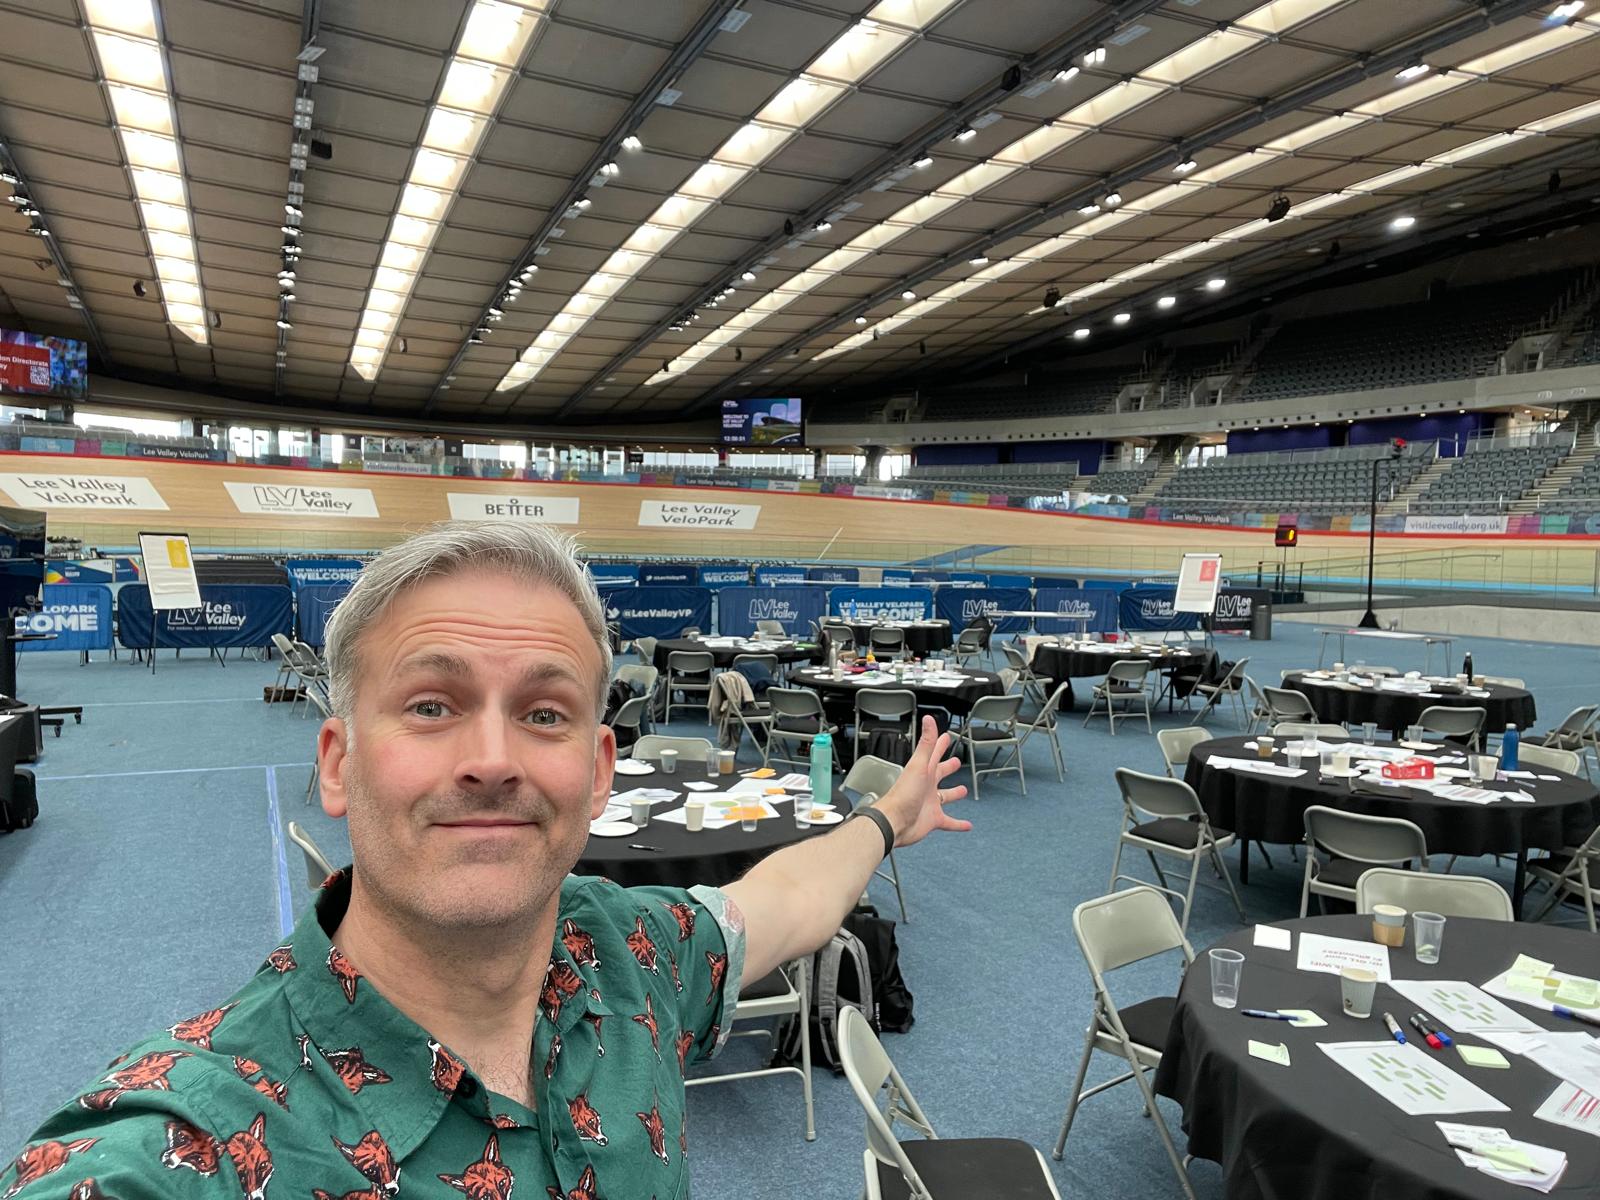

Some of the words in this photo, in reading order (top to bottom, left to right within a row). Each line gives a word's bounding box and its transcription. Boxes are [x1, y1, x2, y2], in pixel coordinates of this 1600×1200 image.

[143, 447, 155, 455] Lee
[156, 448, 178, 458] Valley
[179, 449, 209, 459] VeloPark
[18, 477, 57, 489] Lee
[60, 477, 127, 493] Valley
[34, 491, 137, 505] VeloPark
[253, 486, 298, 507] LV
[300, 488, 332, 498] Lee
[302, 498, 353, 510] Valley
[485, 501, 544, 516] BETTER
[661, 504, 688, 513] Lee
[694, 505, 740, 518] Valley
[661, 515, 735, 525] VeloPark
[1172, 512, 1184, 520] Lee
[1185, 513, 1202, 523] Valley
[1410, 520, 1501, 532] visitleevalley.org.uk
[773, 599, 790, 609] Lee
[982, 600, 999, 609] Lee
[1076, 600, 1090, 609] Lee
[1159, 600, 1171, 608] Lee
[1216, 595, 1238, 617] LV
[1237, 595, 1252, 606] Lee
[43, 604, 97, 613] LOPARK
[205, 601, 232, 613] Lee
[748, 599, 774, 619] LV
[962, 600, 984, 618] LV
[623, 608, 692, 619] @LeeValleyVP
[772, 609, 799, 620] Valley
[206, 613, 247, 627] Valley
